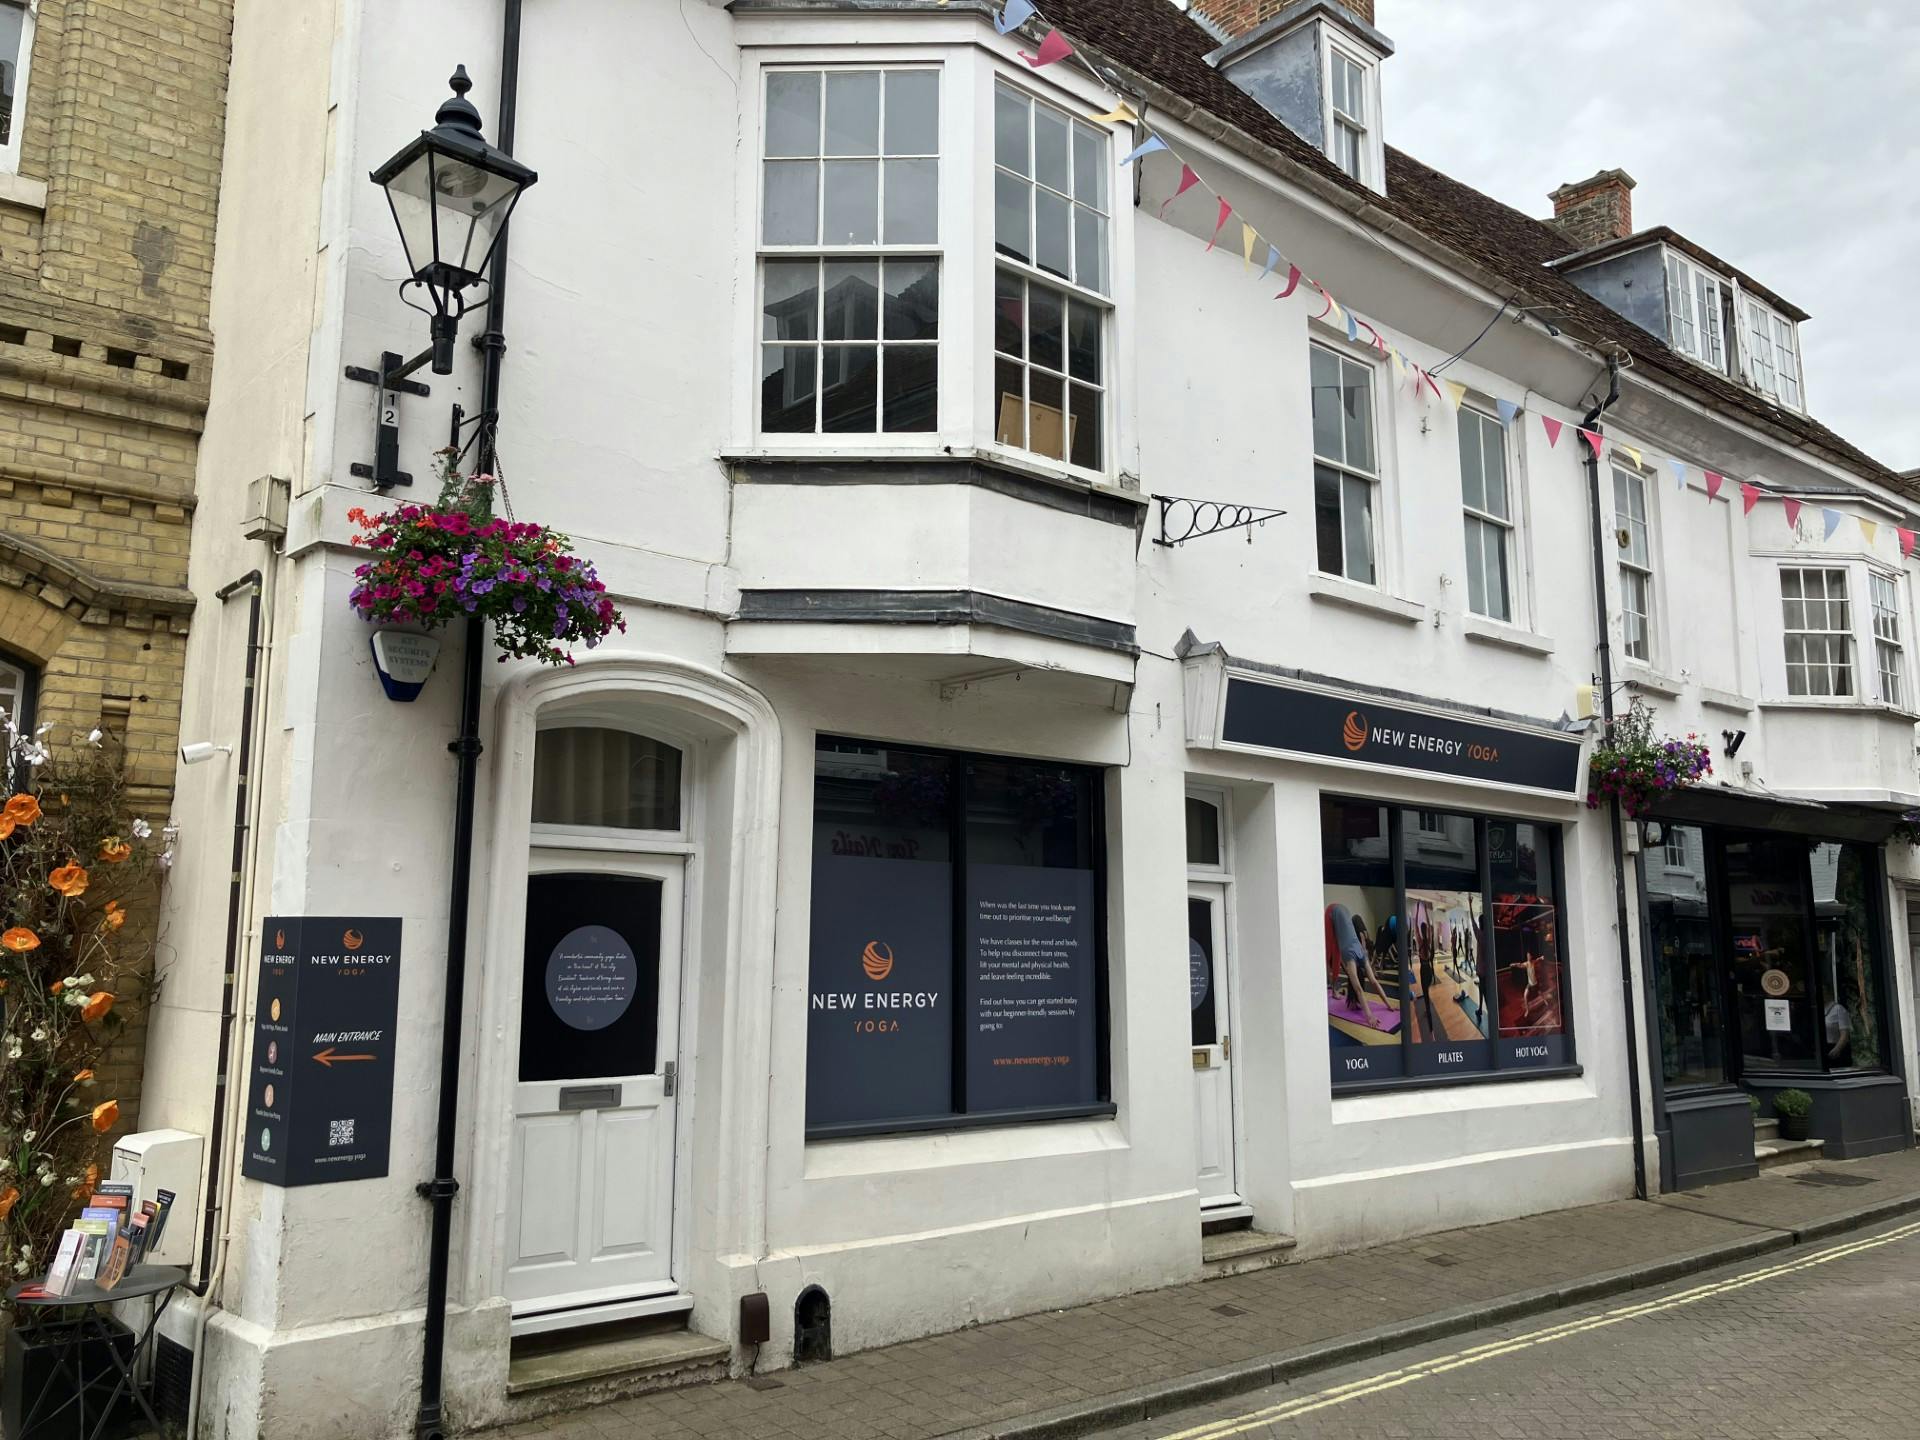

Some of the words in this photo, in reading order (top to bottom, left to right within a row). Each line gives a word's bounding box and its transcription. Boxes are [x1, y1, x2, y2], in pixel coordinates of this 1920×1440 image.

[388, 646, 430, 658] SECURITY
[388, 656, 429, 667] SYSTEMS
[1372, 727, 1404, 746] NEW
[1408, 733, 1462, 756] ENERGY
[1467, 744, 1499, 762] YOGA
[1008, 914, 1032, 922] prioritise
[988, 949, 1000, 958] help
[264, 954, 274, 964] NEW
[276, 954, 296, 964] ENERGY
[311, 956, 340, 964] NEW
[344, 955, 392, 964] ENERGY
[1031, 961, 1052, 970] physical
[1006, 973, 1024, 982] feeling
[812, 993, 856, 1010] NEW
[864, 992, 938, 1008] ENERGY
[1064, 997, 1078, 1006] today
[1069, 1008, 1076, 1016] by
[854, 1020, 900, 1032] YOGA
[980, 1023, 996, 1032] going
[313, 1032, 337, 1044] MAIN
[338, 1030, 382, 1042] ENTRANCE
[1515, 1048, 1530, 1058] HOT
[1530, 1046, 1548, 1056] YOGA
[992, 1056, 1070, 1066] www.newenergy.yoga
[1438, 1052, 1464, 1063] PILATES
[1346, 1058, 1368, 1070] YOGA
